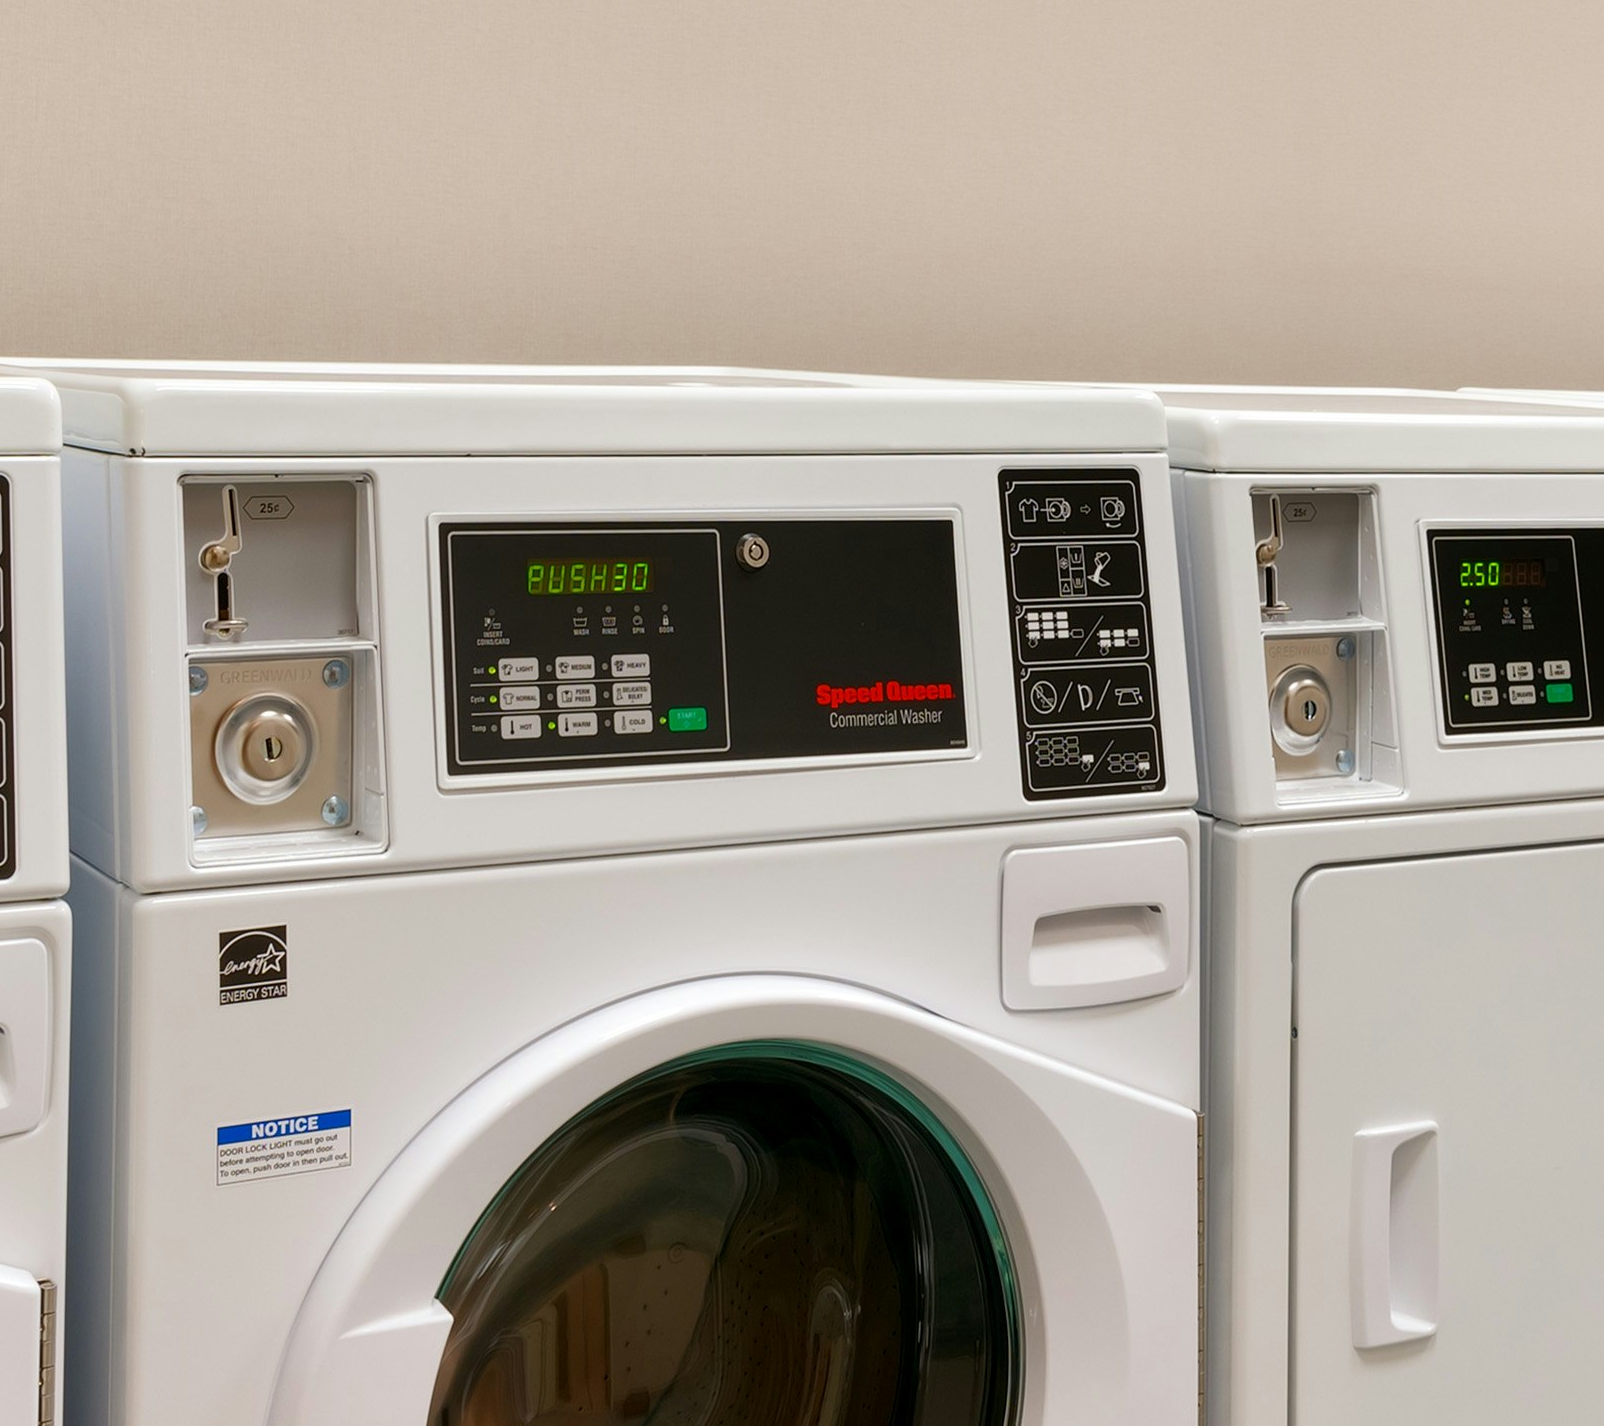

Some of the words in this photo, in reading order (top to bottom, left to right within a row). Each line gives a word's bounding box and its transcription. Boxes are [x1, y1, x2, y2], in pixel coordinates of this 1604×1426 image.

[1460, 562, 1499, 586] 2.50
[816, 682, 883, 708] Speed
[886, 680, 952, 701] Queen
[829, 710, 897, 728] Commercial
[900, 709, 943, 724] Washer
[221, 988, 260, 1004] ENERGY
[261, 985, 287, 998] STAR
[251, 1116, 318, 1138] NOTICE
[220, 1147, 244, 1157] DOOR
[245, 1144, 267, 1154] LOCK
[269, 1140, 293, 1151] LIGHT
[294, 1137, 313, 1146] must
[314, 1136, 324, 1145] go
[326, 1134, 338, 1142] out
[219, 1157, 244, 1168] before
[245, 1150, 285, 1164] attempting
[287, 1150, 295, 1158] to
[296, 1148, 315, 1158] open
[253, 1163, 272, 1174] push
[273, 1160, 291, 1169] door
[293, 1158, 300, 1166] in
[301, 1156, 318, 1165] then
[319, 1153, 333, 1164] pull
